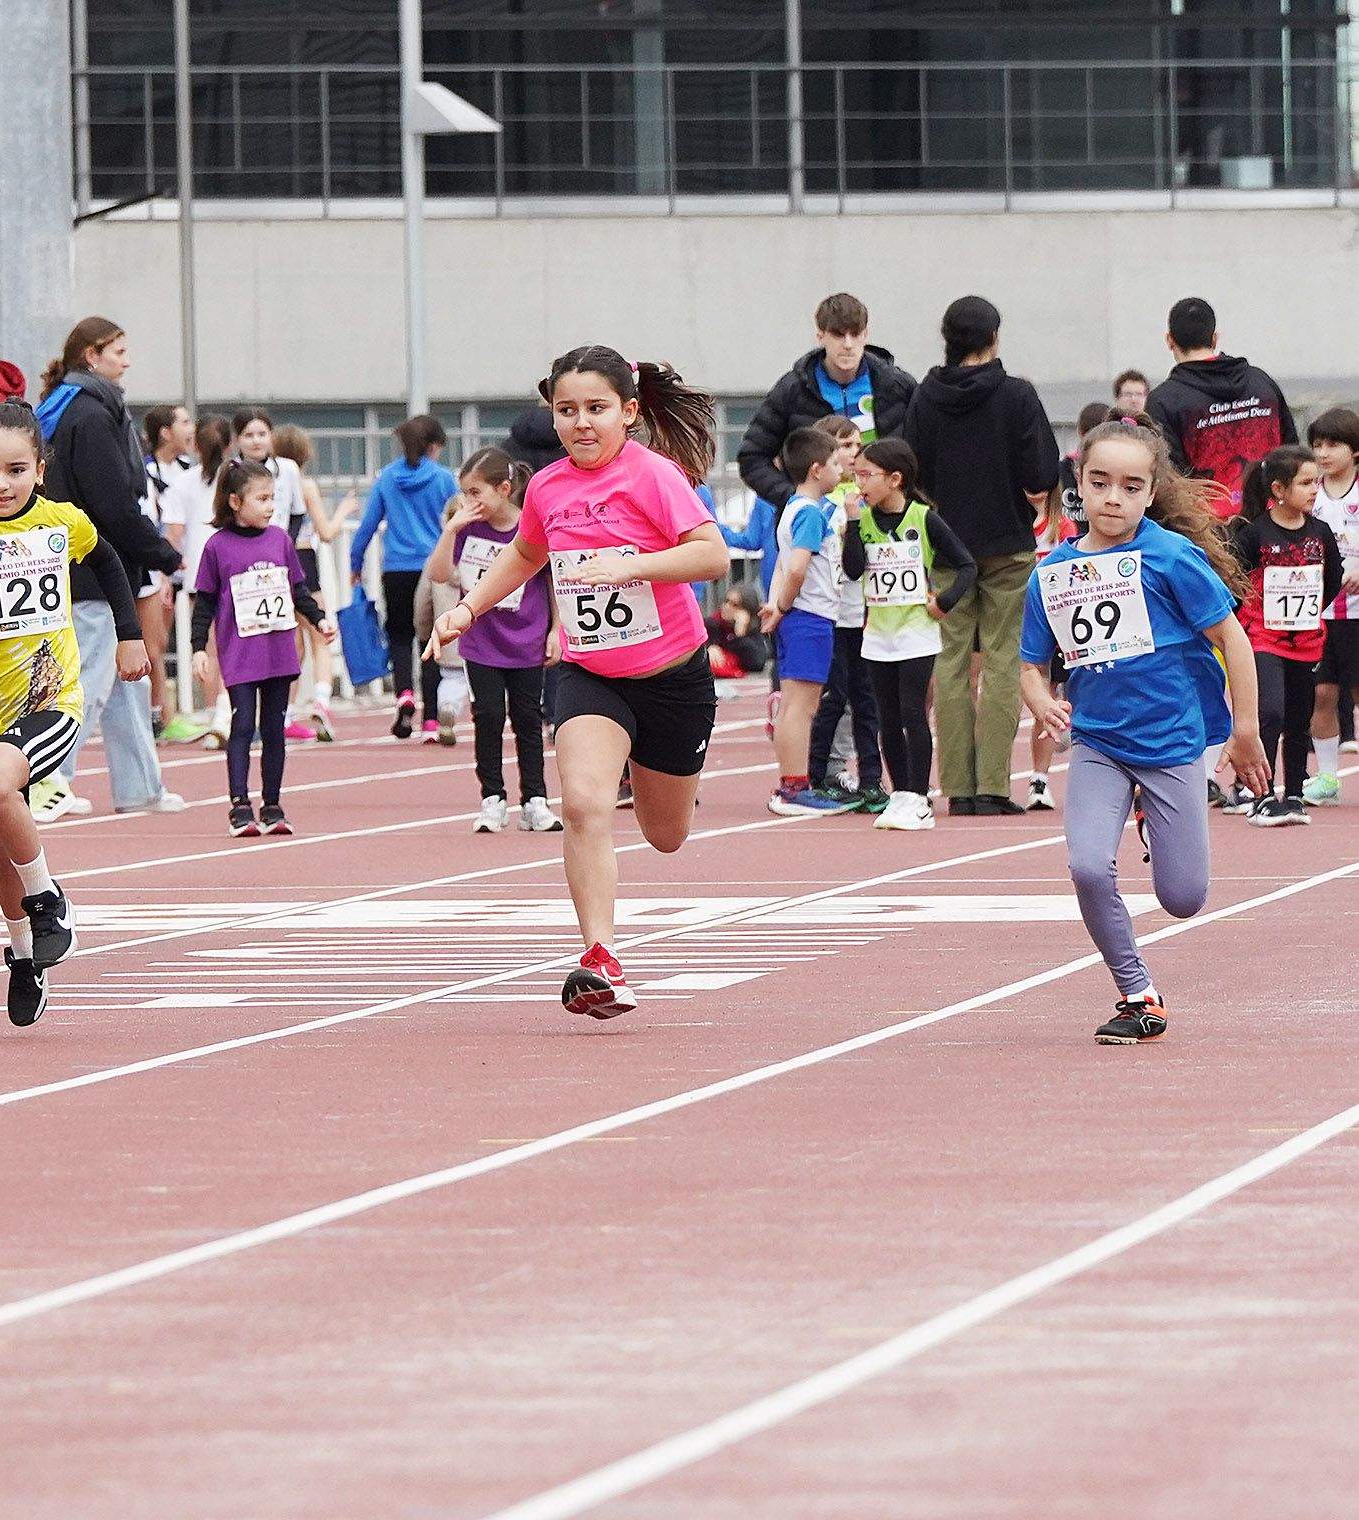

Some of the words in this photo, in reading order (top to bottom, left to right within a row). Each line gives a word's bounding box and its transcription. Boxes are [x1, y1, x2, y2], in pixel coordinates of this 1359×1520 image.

[1209, 403, 1231, 414] Club
[1232, 396, 1260, 409] Escola
[1196, 419, 1208, 429] de
[1208, 410, 1249, 426] Atletismo
[1250, 407, 1272, 418] Deza
[15, 561, 27, 569] DE
[27, 558, 46, 567] REIS
[22, 568, 37, 577] JIM
[38, 564, 63, 574] SPORTS
[570, 587, 596, 595] PREMIO
[596, 585, 611, 593] JIM
[611, 580, 644, 591] SPORTS
[870, 569, 917, 594] 190
[1096, 583, 1114, 592] REIS
[1115, 581, 1130, 589] 2025
[1105, 588, 1136, 599] SPORTS
[256, 595, 286, 620] 42
[576, 591, 633, 632] 56
[1277, 594, 1319, 618] 173
[1070, 600, 1121, 645] 69
